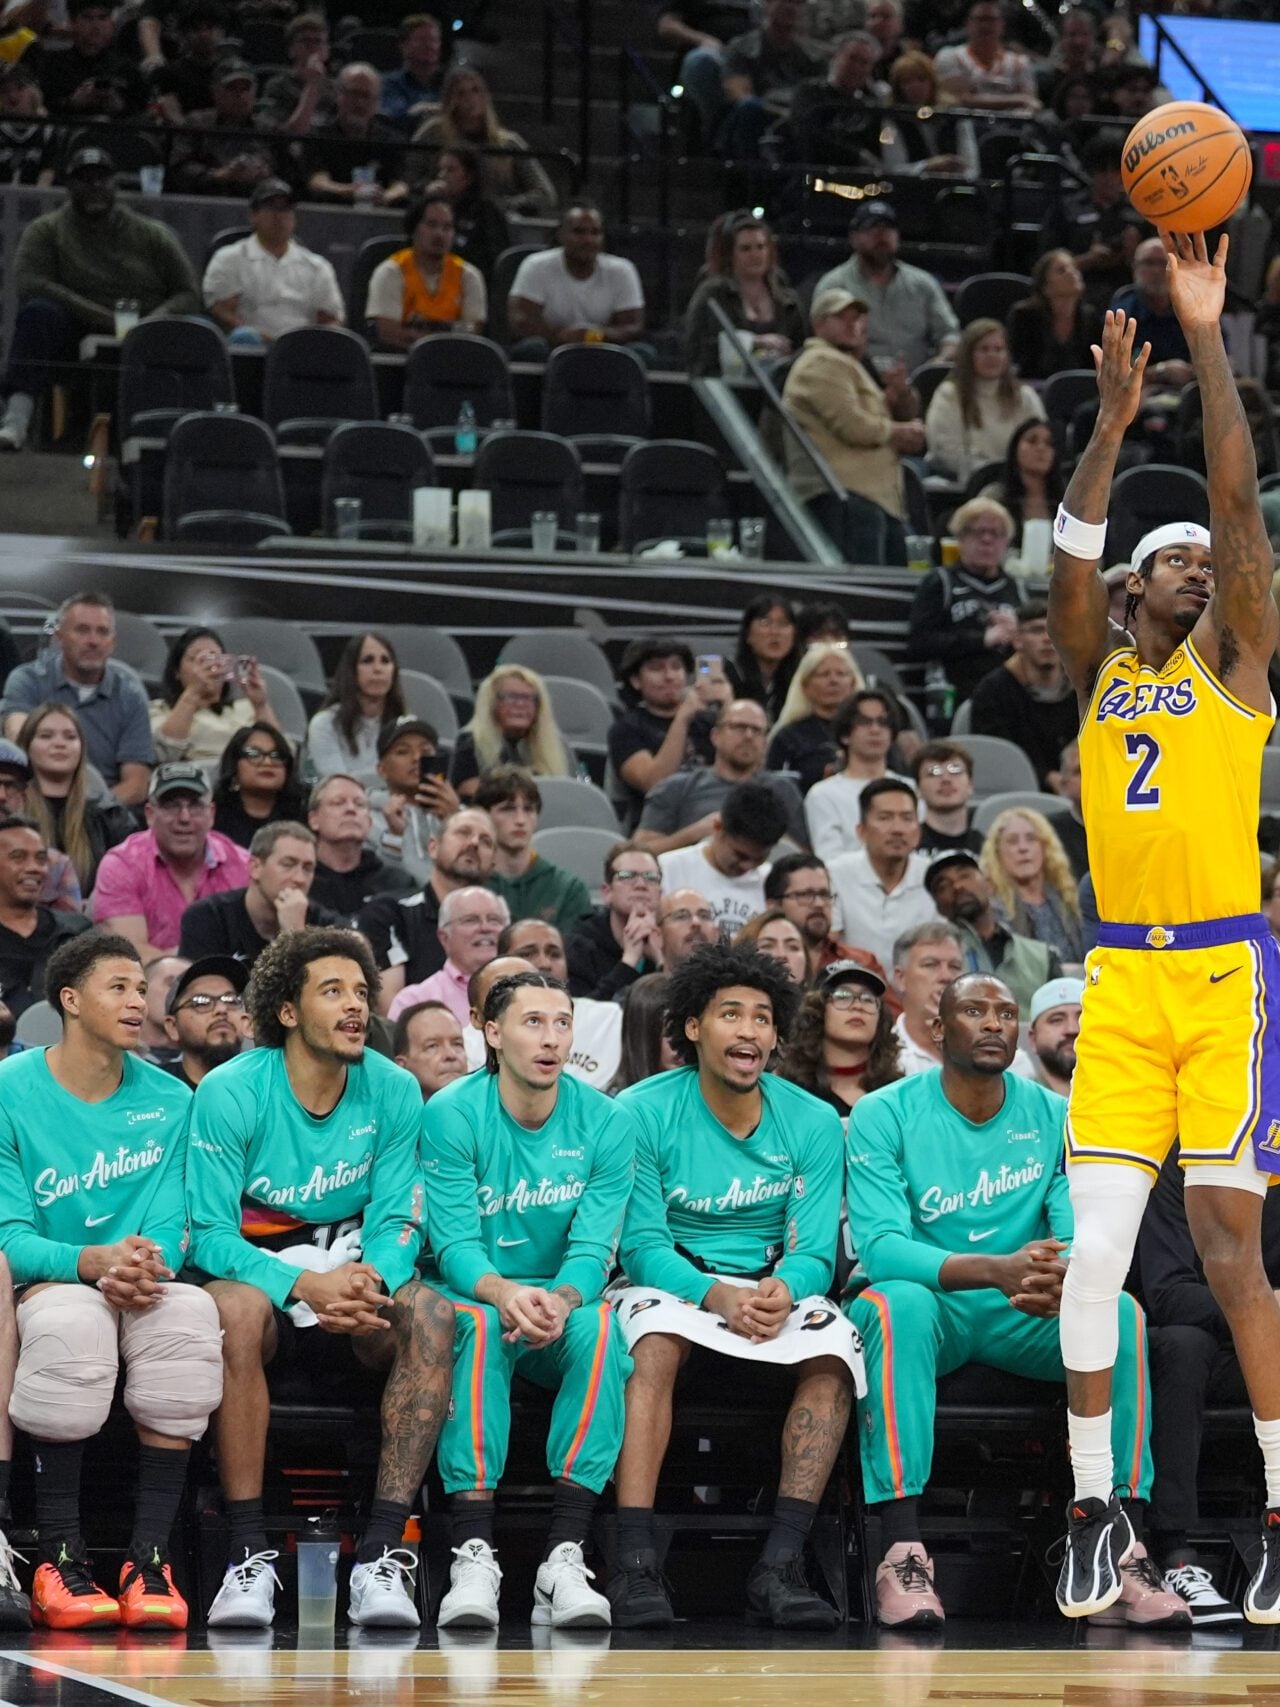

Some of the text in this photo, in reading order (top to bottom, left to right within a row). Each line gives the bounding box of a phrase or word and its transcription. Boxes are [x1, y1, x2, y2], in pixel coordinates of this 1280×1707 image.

[1124, 120, 1197, 173] Wilson
[1125, 732, 1162, 811] 2
[130, 1110, 162, 1122] LEDGER
[34, 1140, 165, 1208] San Antonio
[299, 1152, 373, 1203] Antoni
[505, 1174, 586, 1214] Antonio
[919, 1157, 1045, 1224] San Antonio
